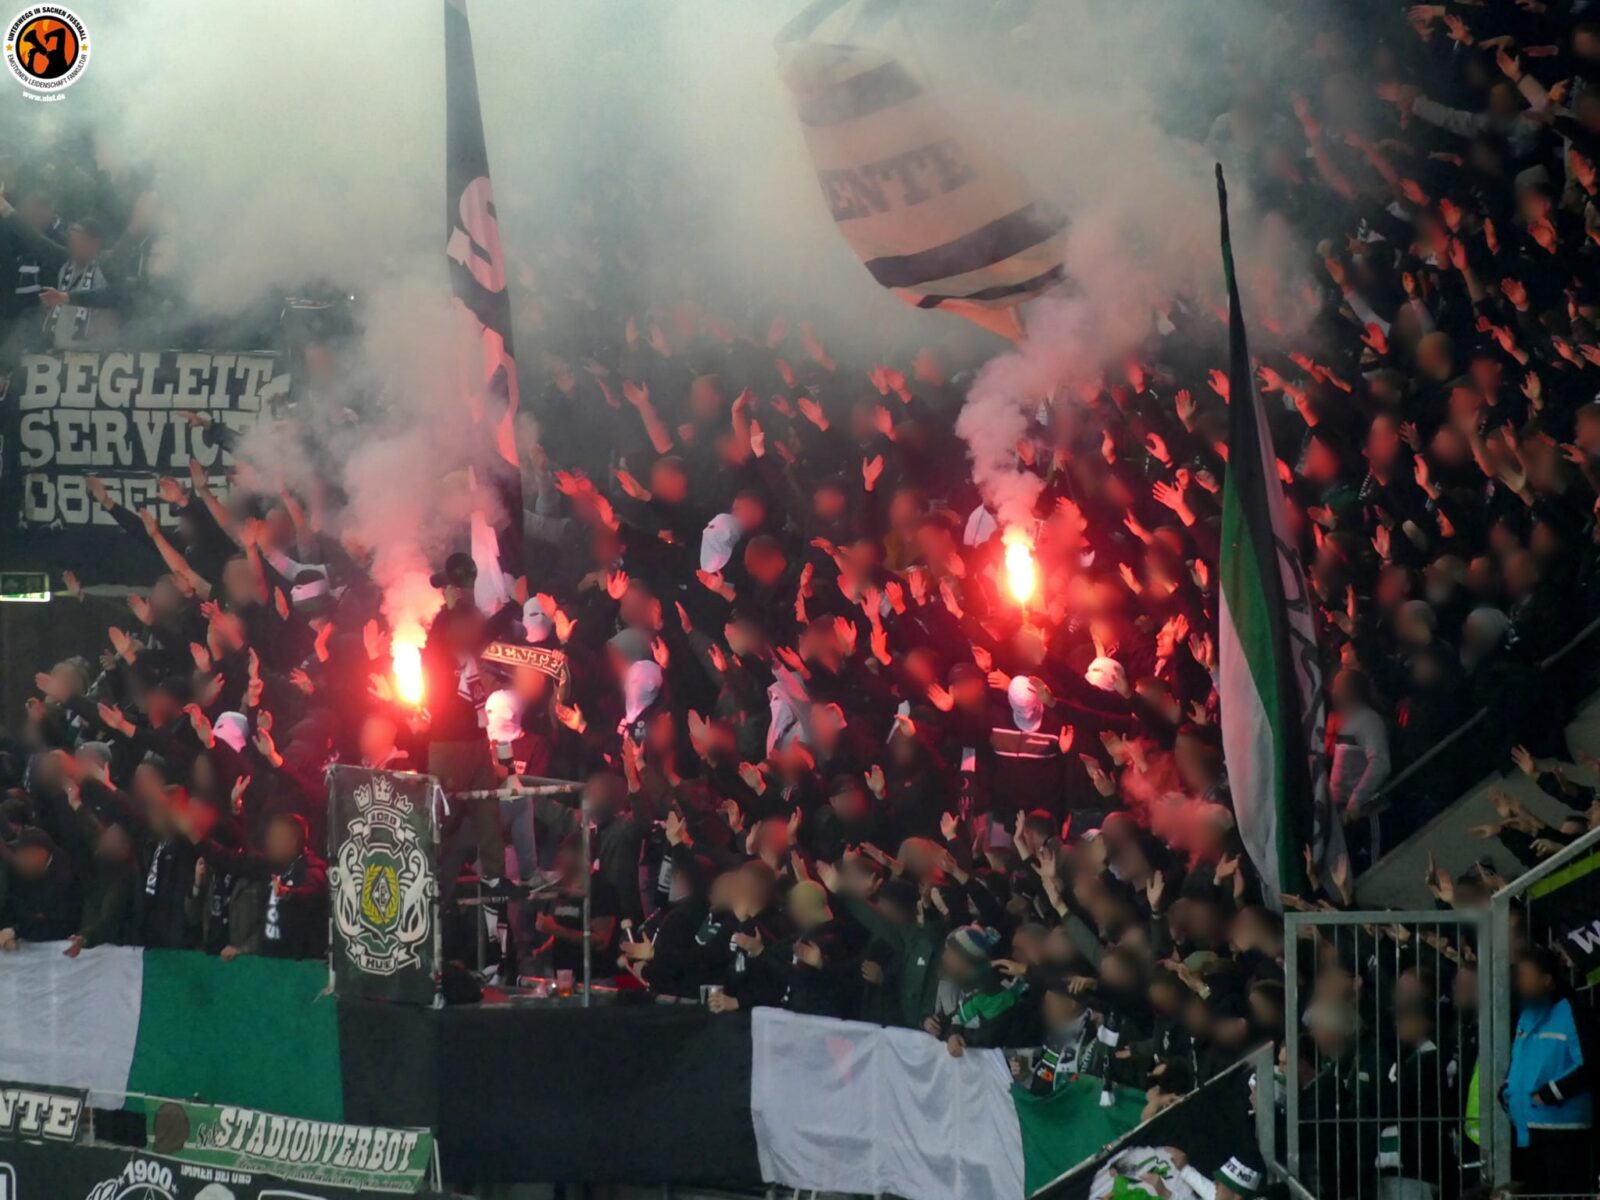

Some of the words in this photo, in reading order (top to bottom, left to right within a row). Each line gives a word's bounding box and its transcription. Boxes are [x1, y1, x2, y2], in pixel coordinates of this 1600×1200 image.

[19, 350, 274, 412] BEGLEIT
[218, 1106, 418, 1173] STADIONVERBOT
[123, 1159, 173, 1192] 1900
